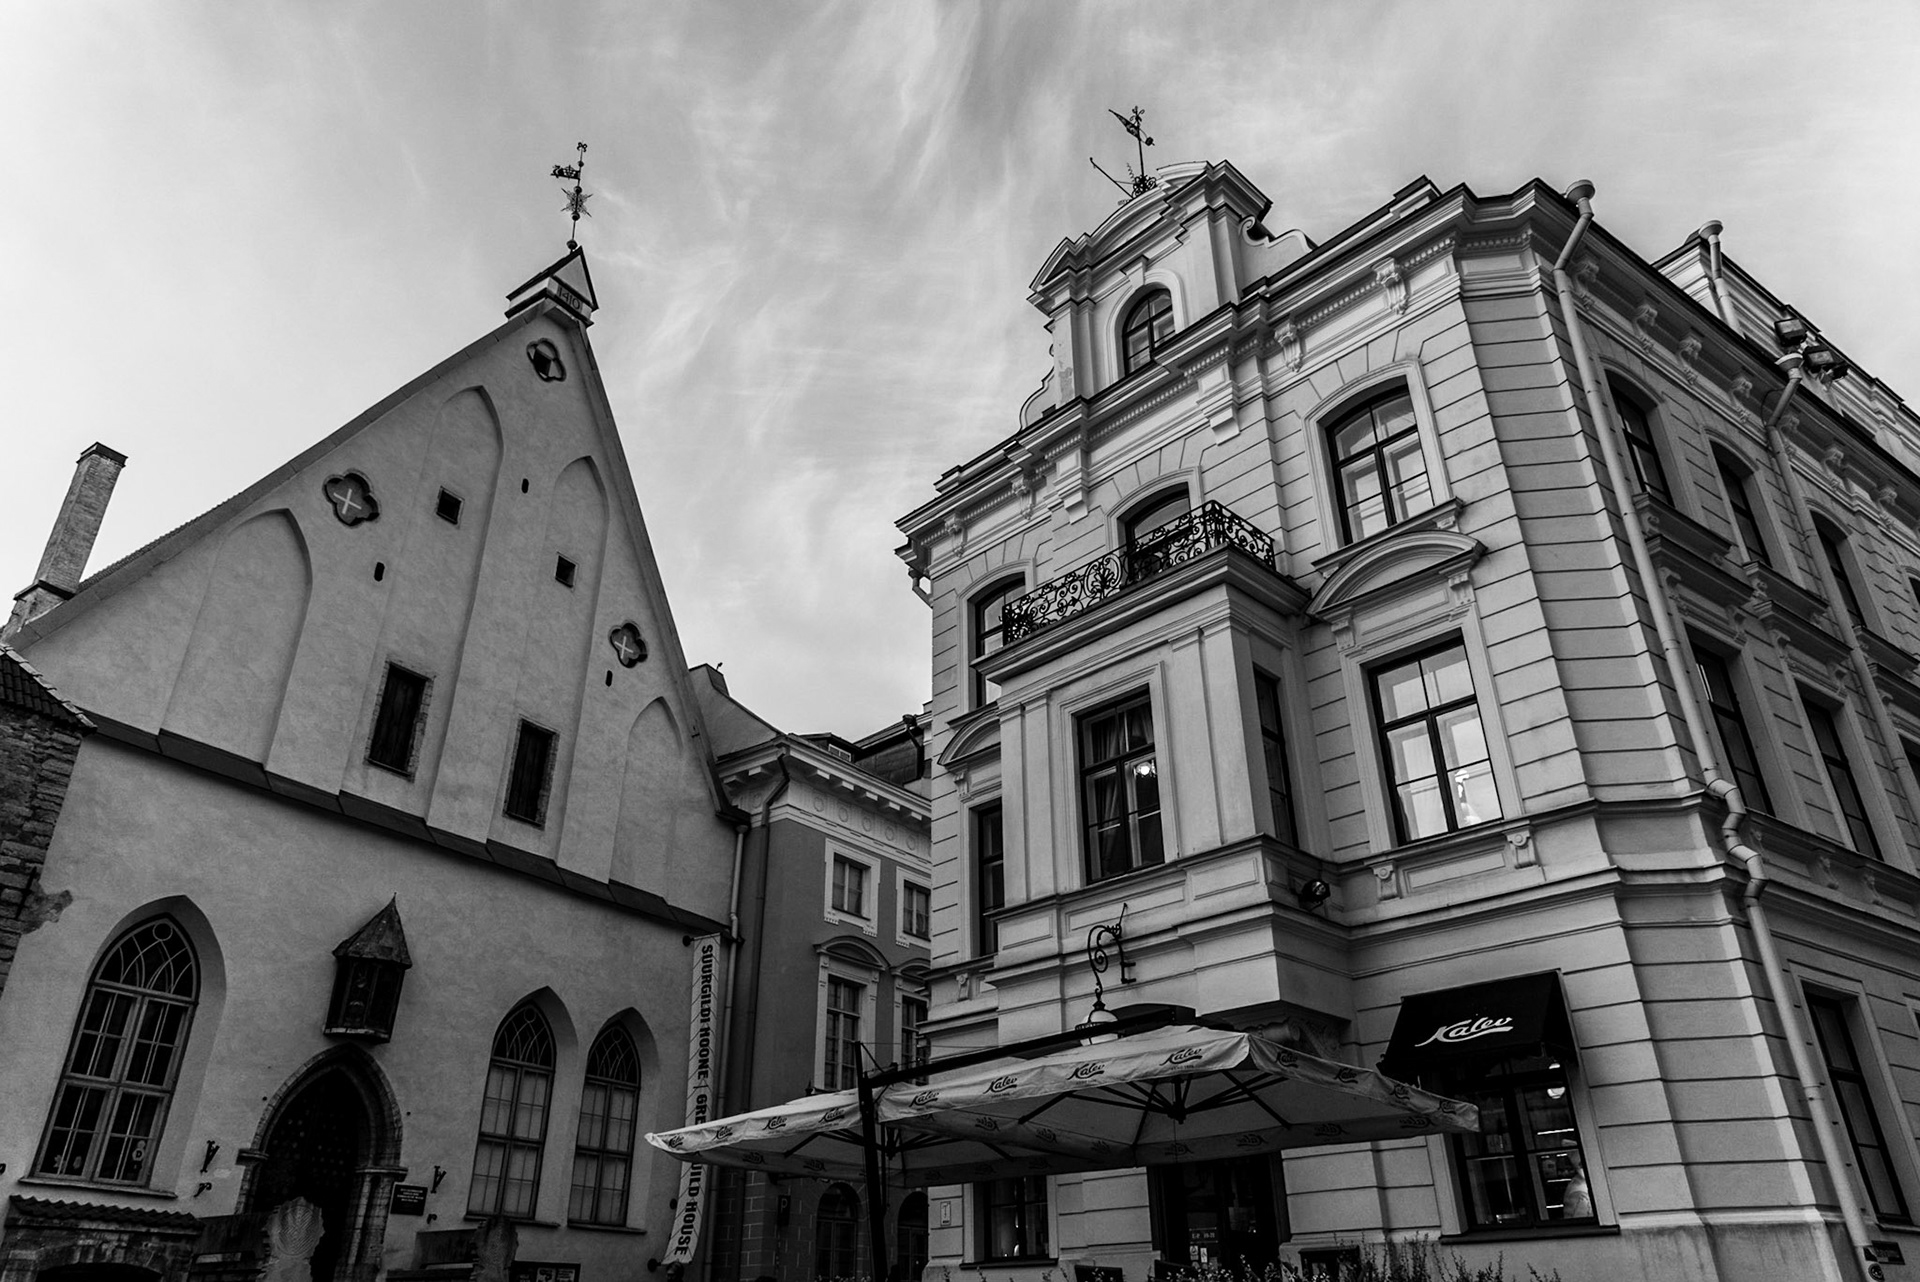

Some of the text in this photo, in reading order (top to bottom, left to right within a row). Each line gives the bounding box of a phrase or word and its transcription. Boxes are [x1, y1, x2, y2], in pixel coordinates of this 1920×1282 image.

[558, 287, 580, 310] 1410
[700, 944, 713, 1024] SUURGILDI
[1414, 1016, 1514, 1047] Kalev
[697, 1026, 710, 1080] HOONE
[1159, 1048, 1203, 1066] Kalev
[982, 1076, 1018, 1094] Kalev
[1067, 1063, 1105, 1080] Kalev
[695, 1094, 707, 1125] GRE
[909, 1090, 940, 1107] Kalev
[688, 1161, 702, 1197] UILD
[780, 1197, 788, 1214] P
[674, 1201, 697, 1256] HOUSE
